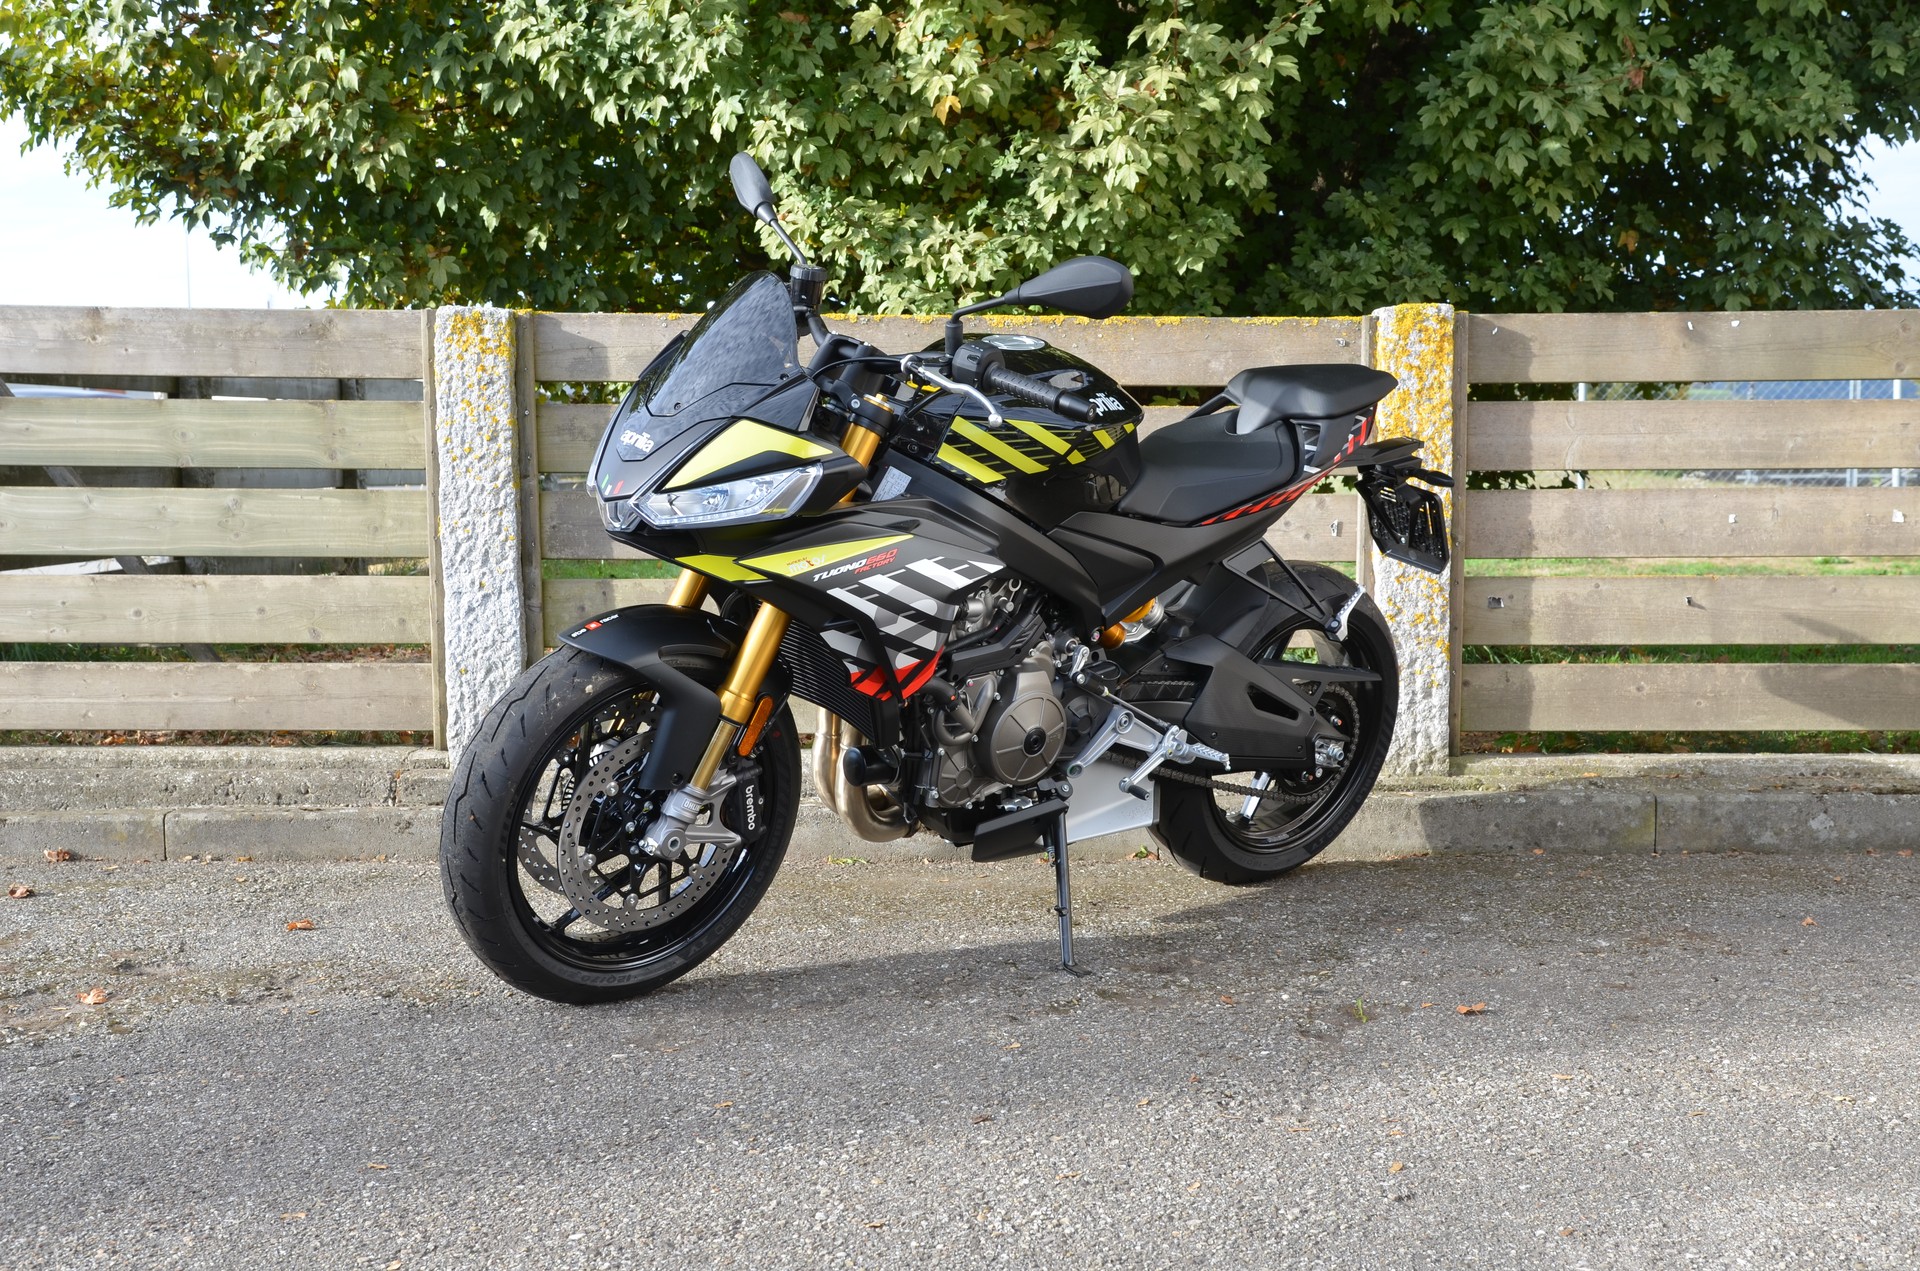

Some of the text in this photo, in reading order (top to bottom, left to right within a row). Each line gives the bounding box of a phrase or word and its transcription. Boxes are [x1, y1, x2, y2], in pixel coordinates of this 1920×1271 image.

[1089, 392, 1125, 416] prilia
[620, 429, 655, 453] aprilia
[854, 556, 896, 575] FACTORY
[745, 784, 757, 831] brembo
